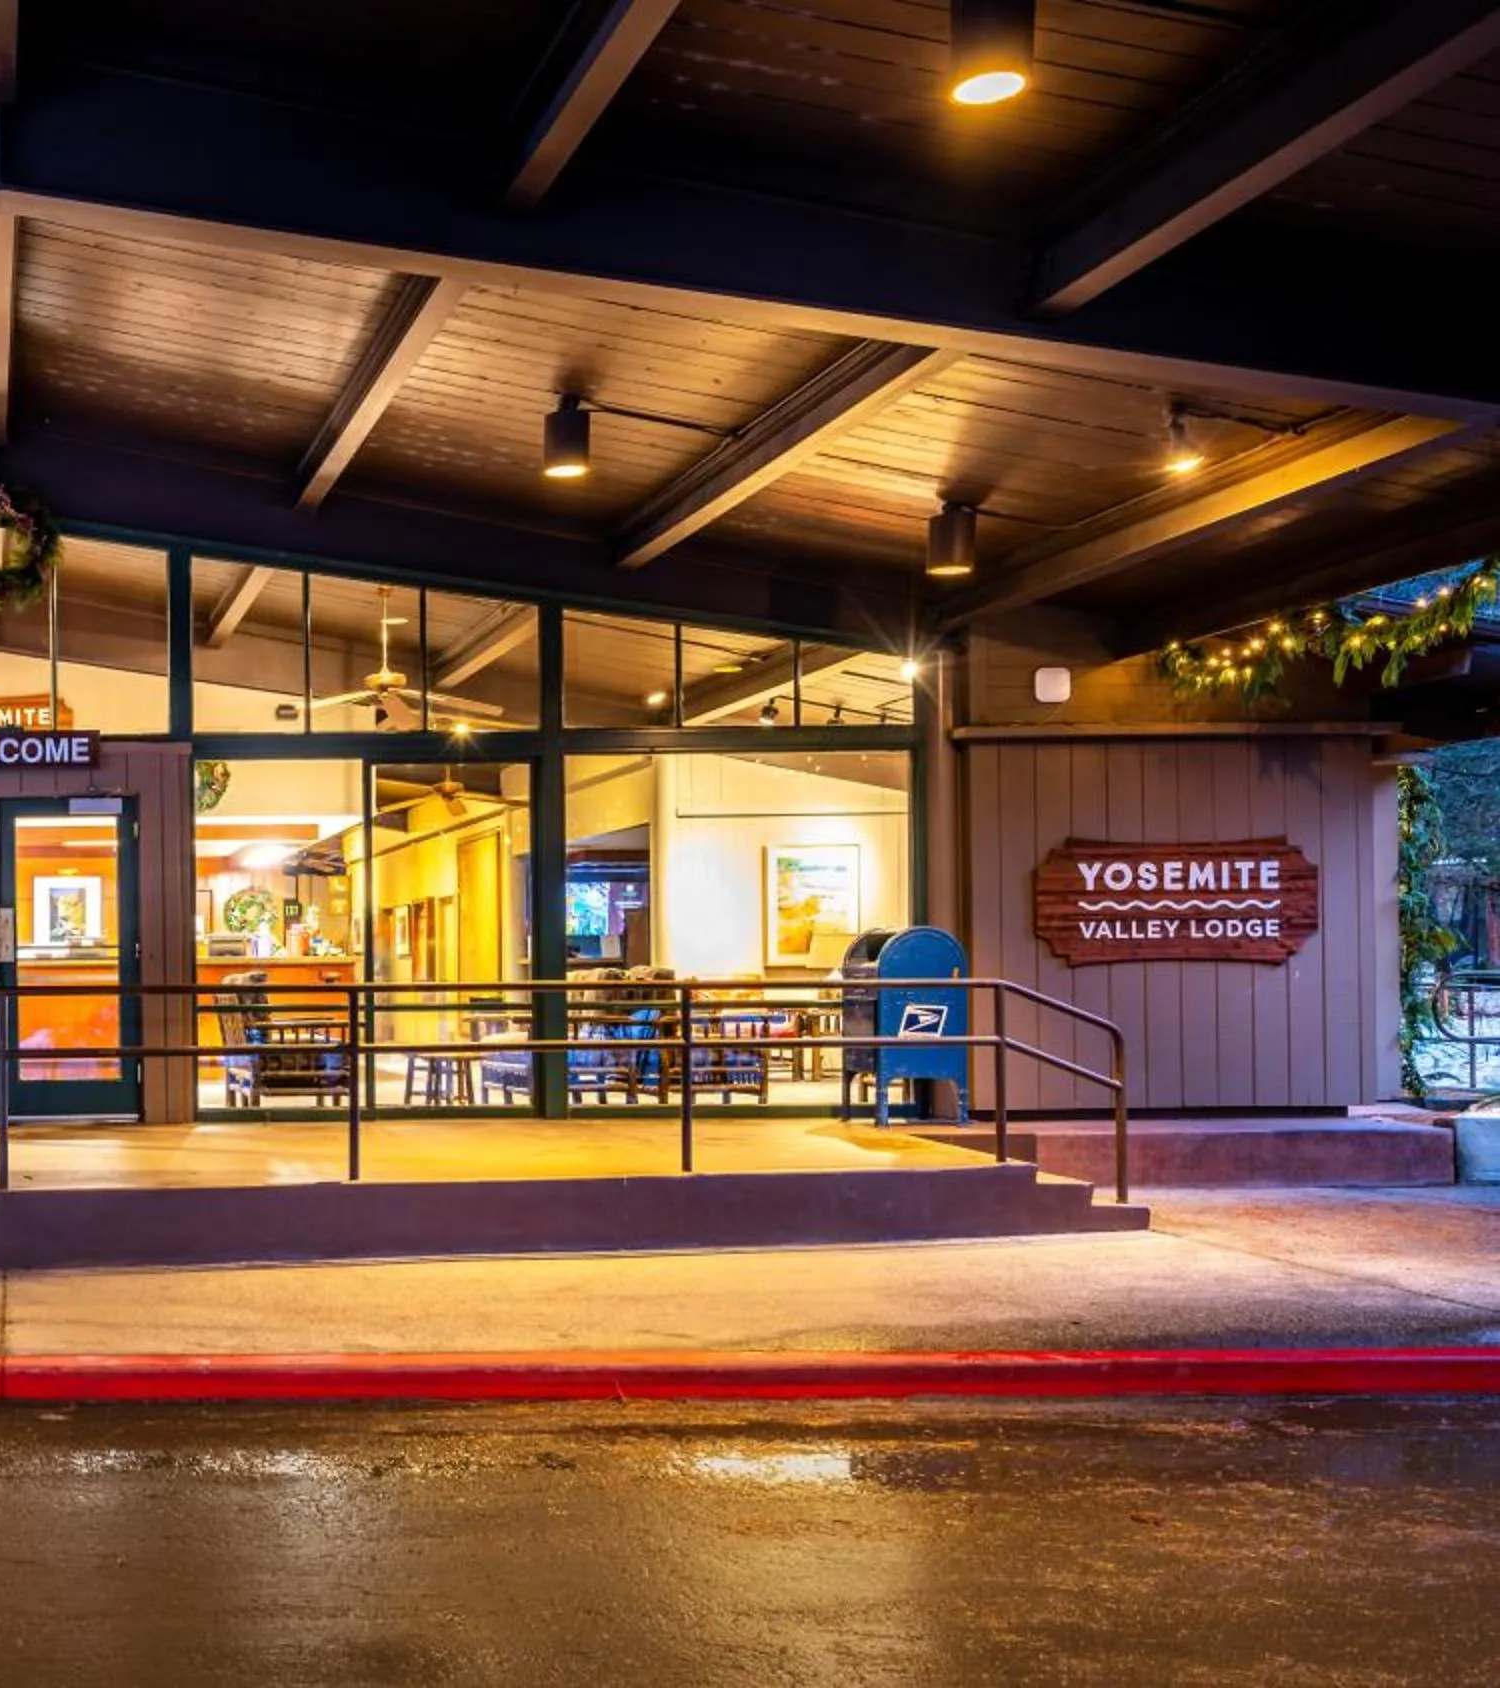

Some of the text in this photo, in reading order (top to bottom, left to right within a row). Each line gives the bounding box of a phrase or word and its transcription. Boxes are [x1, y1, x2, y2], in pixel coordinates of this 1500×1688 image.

[1077, 861, 1280, 891] YOSEMITE
[1079, 919, 1280, 939] VALLEY LODGE
